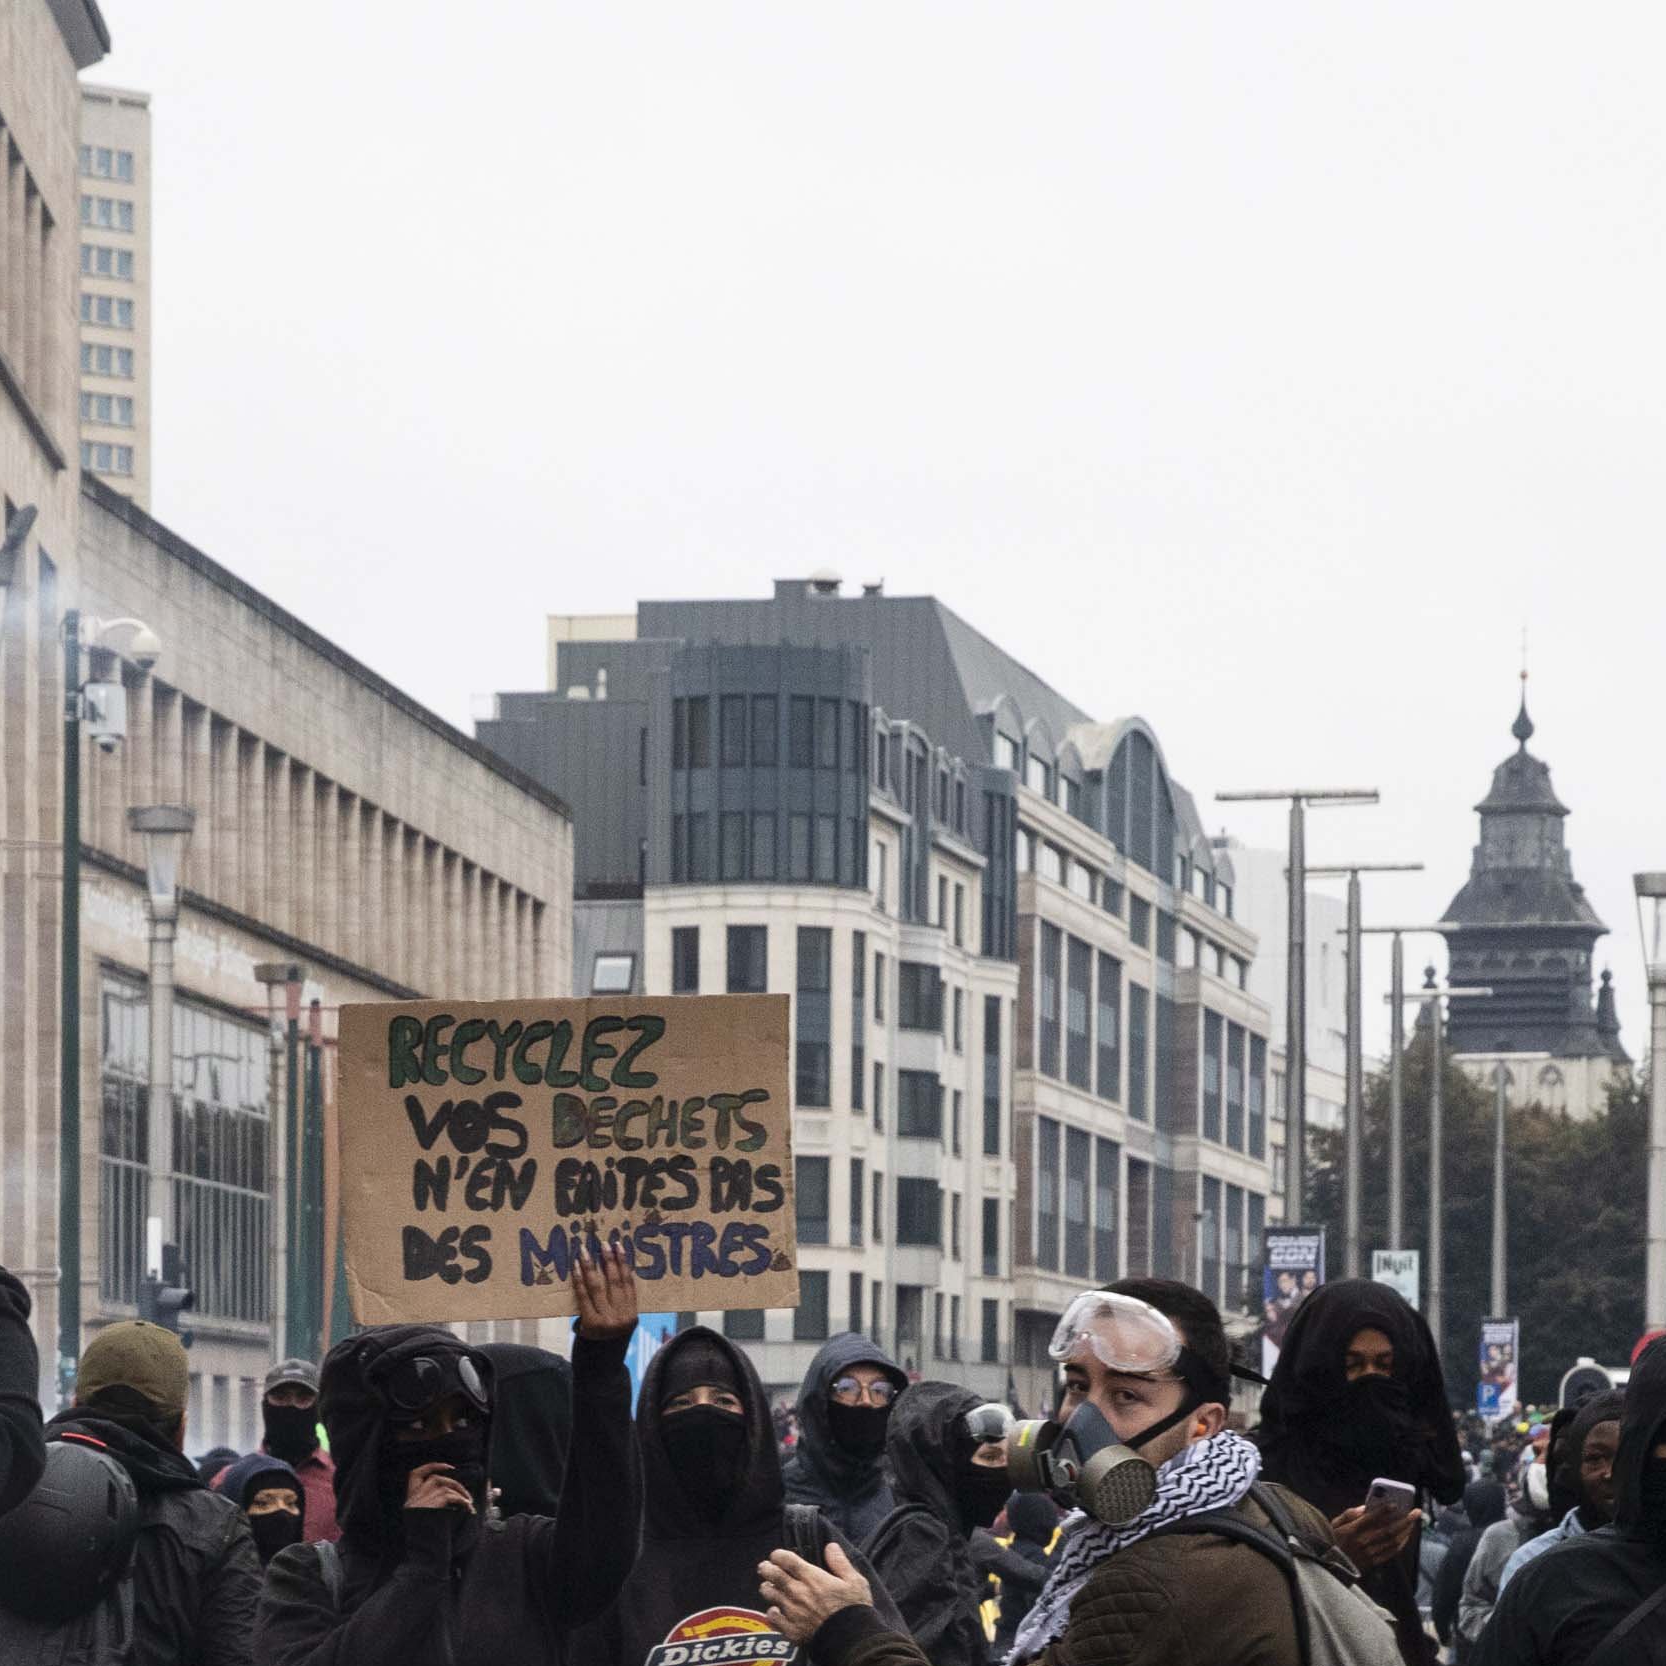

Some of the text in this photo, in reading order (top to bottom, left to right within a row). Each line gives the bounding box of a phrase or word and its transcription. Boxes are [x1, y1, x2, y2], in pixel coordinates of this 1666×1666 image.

[389, 1014, 666, 1092] RECYCLEZ
[405, 1089, 770, 1160] VOS DECHETS
[412, 1154, 537, 1212] N'EN
[710, 1155, 785, 1215] PAS
[403, 1224, 492, 1285] DES
